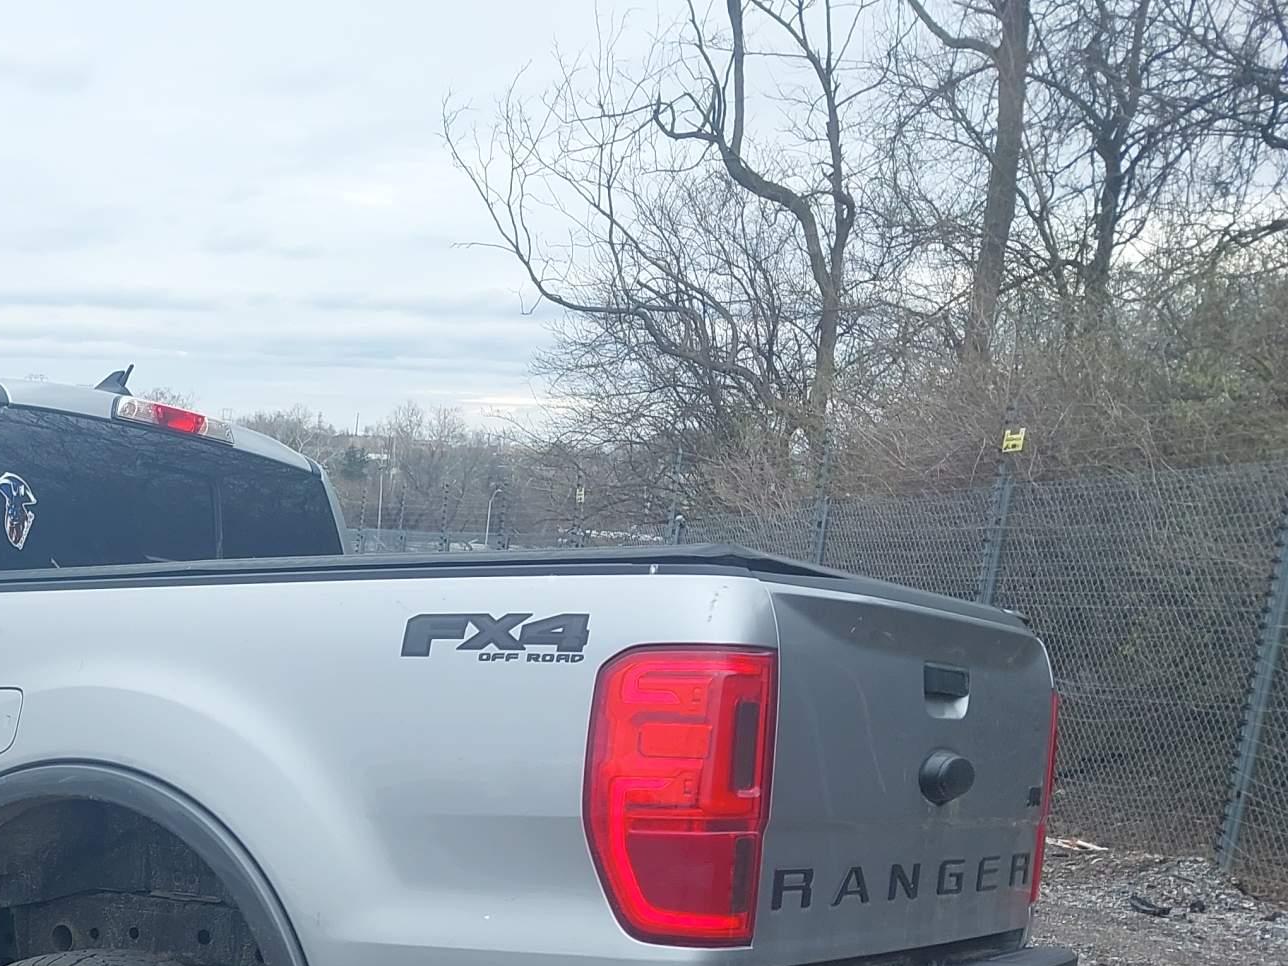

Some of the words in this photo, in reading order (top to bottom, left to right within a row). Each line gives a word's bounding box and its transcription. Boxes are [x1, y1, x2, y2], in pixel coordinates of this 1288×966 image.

[400, 613, 590, 657] FX4
[477, 652, 520, 663] OFF
[526, 653, 585, 664] ROAD
[771, 852, 1031, 911] RANGER
